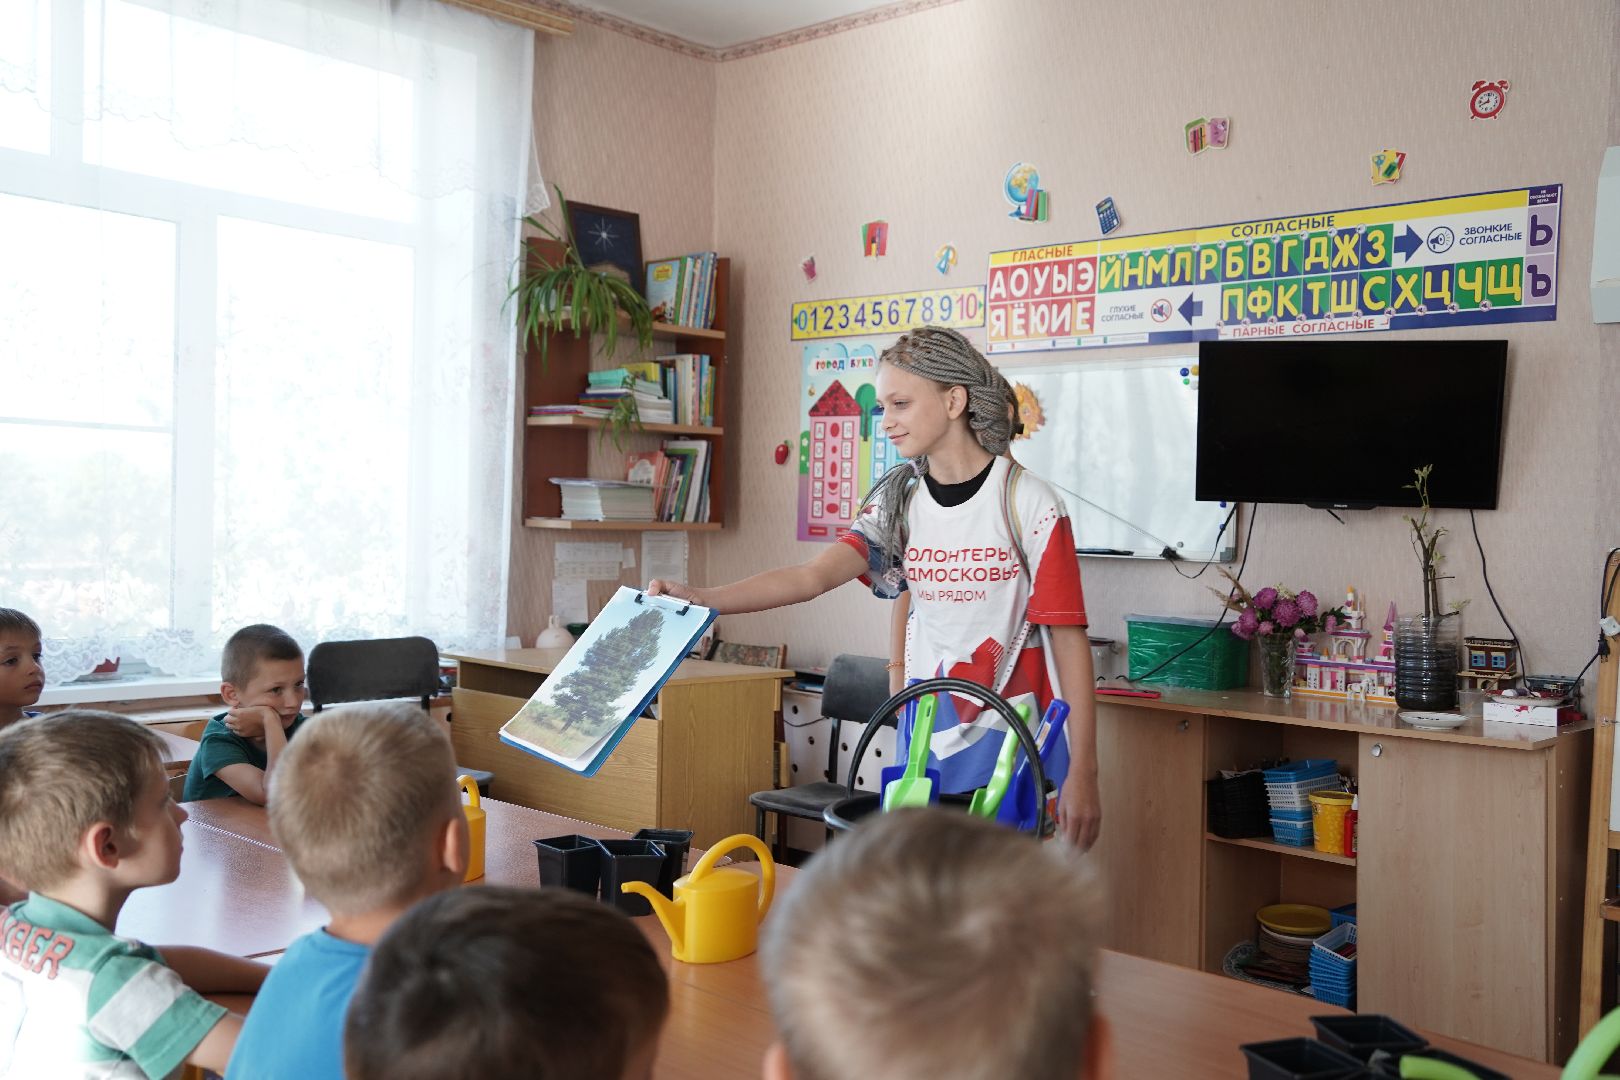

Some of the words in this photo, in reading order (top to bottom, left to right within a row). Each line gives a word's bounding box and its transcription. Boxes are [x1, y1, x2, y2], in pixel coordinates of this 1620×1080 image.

[1232, 216, 1335, 238] СОГЛАСНЫЕ
[1464, 223, 1513, 235] ЗВОНКИЕ
[1459, 232, 1522, 246] СОГЛАСНЫЕ
[1012, 246, 1073, 262] ГЛАСНЫЕ
[1109, 304, 1137, 314] ГЛУХИЕ
[1101, 311, 1145, 322] СОГЛАСНЫЕ
[1233, 325, 1285, 338] ПАРНЫЕ
[1292, 319, 1375, 334] СОГЛАСНЫЕ
[816, 359, 845, 370] ГОРОД
[905, 547, 1012, 563] ОЛОНТЕРЫ
[938, 590, 986, 603] РЯДОМ
